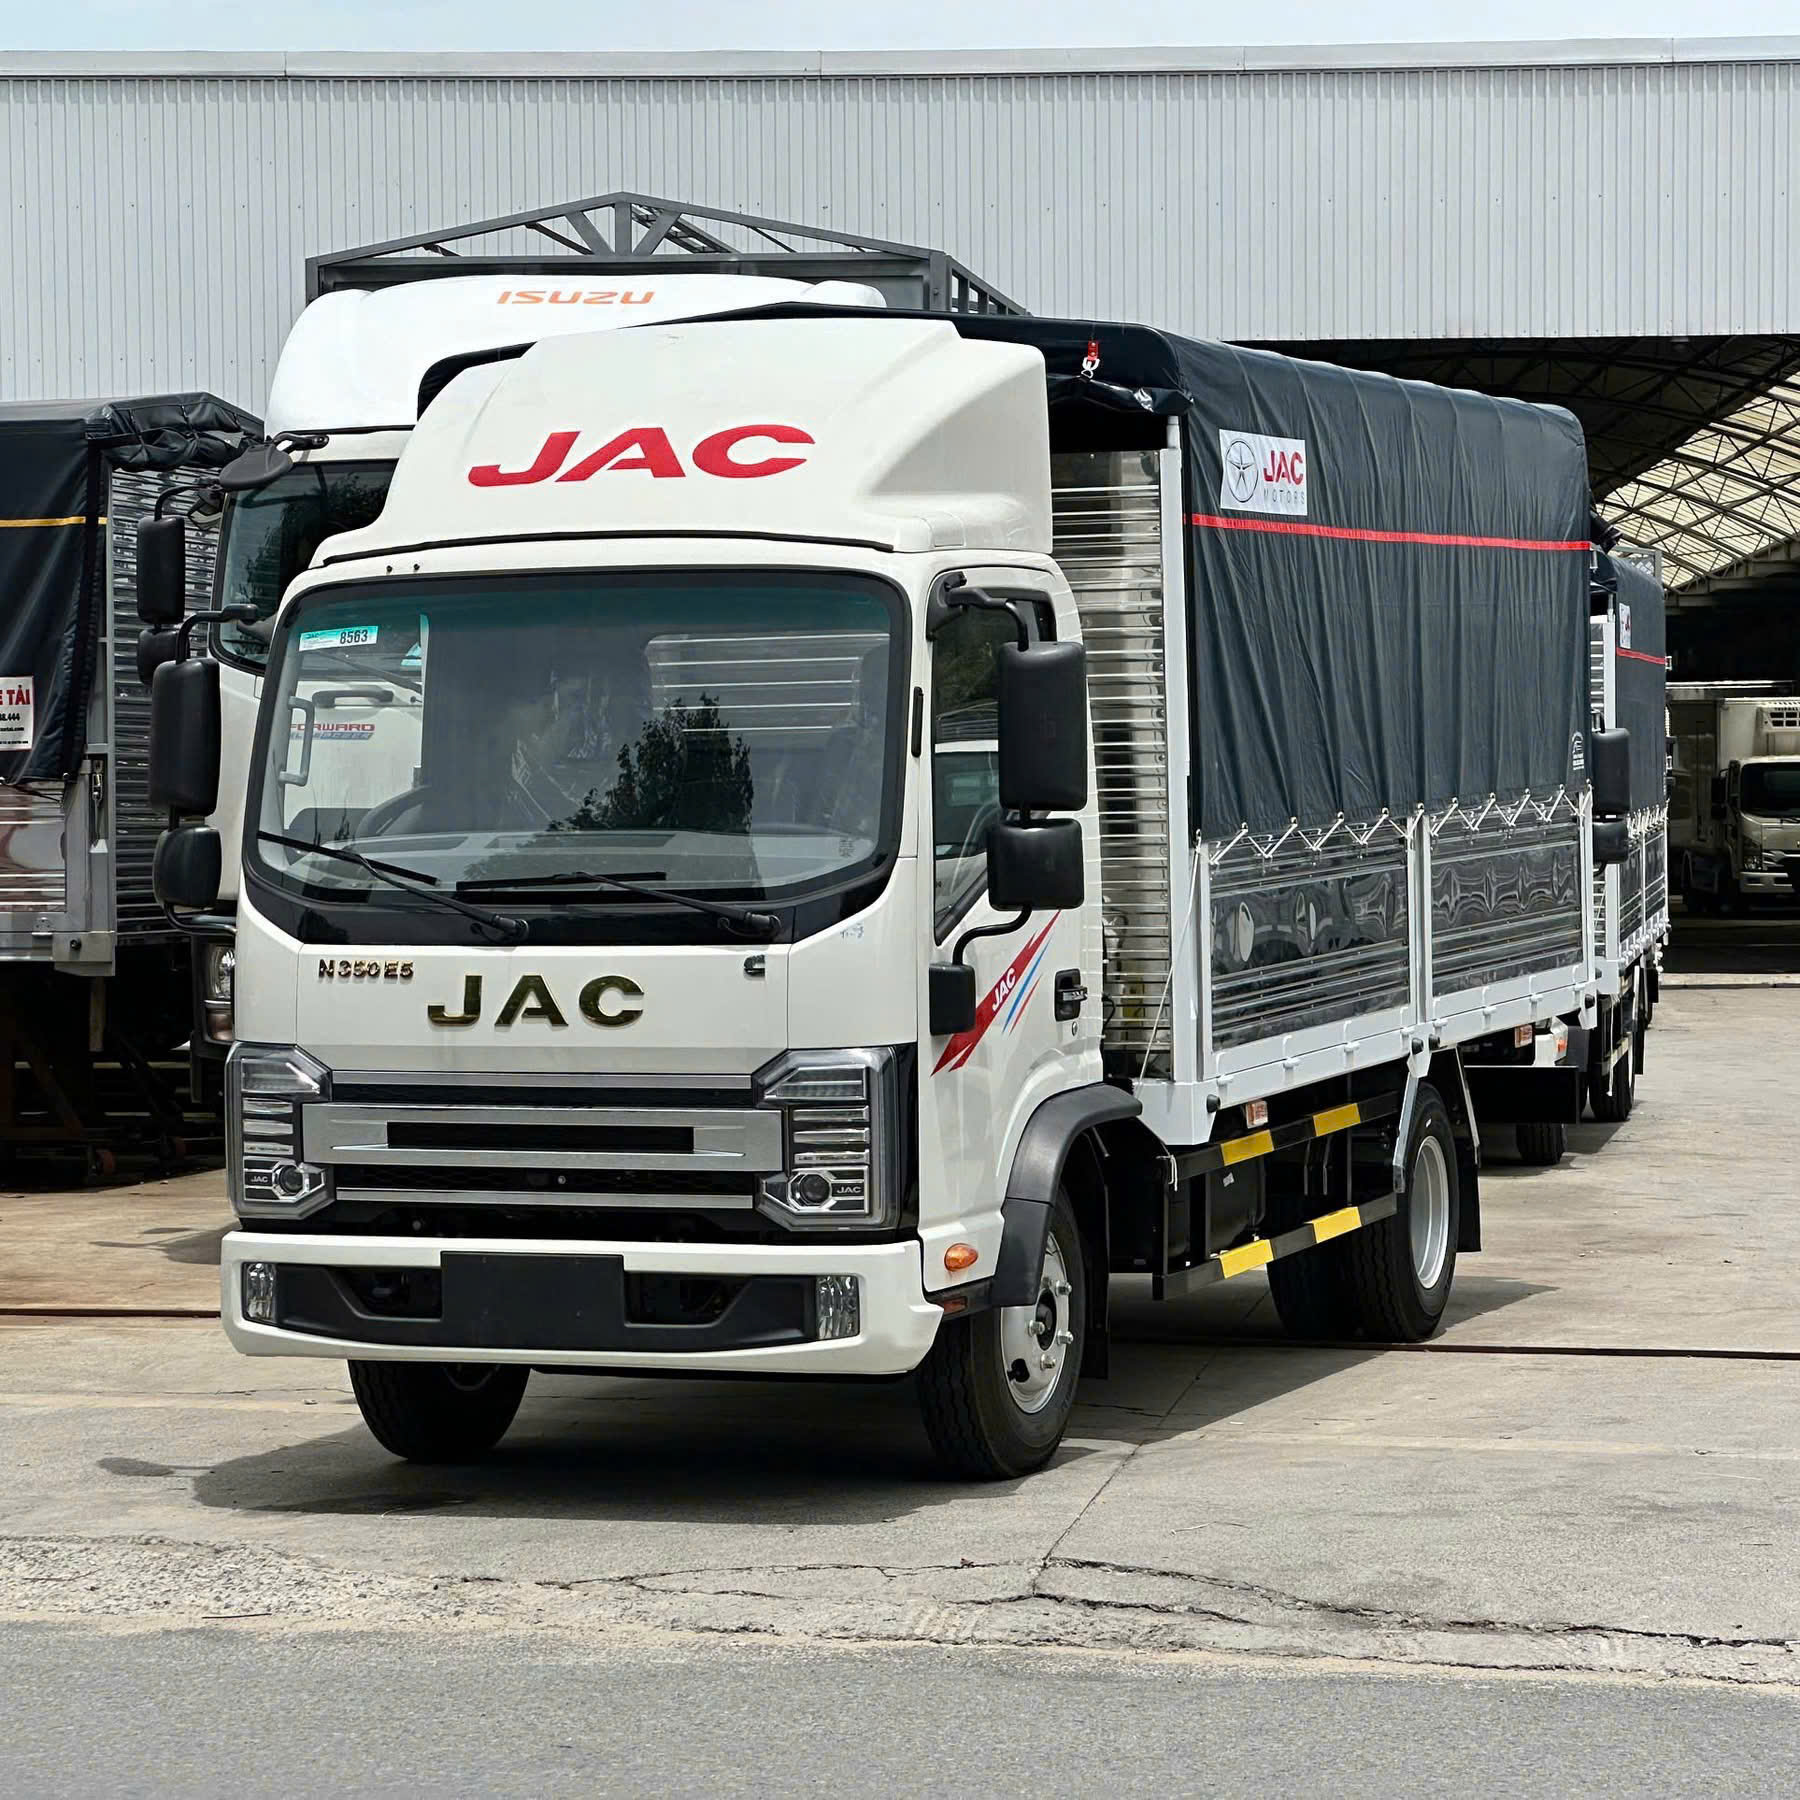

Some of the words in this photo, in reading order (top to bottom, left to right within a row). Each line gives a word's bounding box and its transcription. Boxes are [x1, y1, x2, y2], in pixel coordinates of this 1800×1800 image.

[497, 291, 656, 304] ISUZU
[468, 424, 816, 487] JAC
[1263, 450, 1304, 485] JAC
[1264, 489, 1305, 504] MOTORS
[340, 630, 368, 644] 8563
[6, 684, 31, 705] TẢI
[318, 959, 415, 979] N350E5
[991, 967, 1016, 1011] JAC
[427, 975, 645, 1027] JAC
[250, 1175, 269, 1183] JAC
[836, 1186, 862, 1194] JAC
